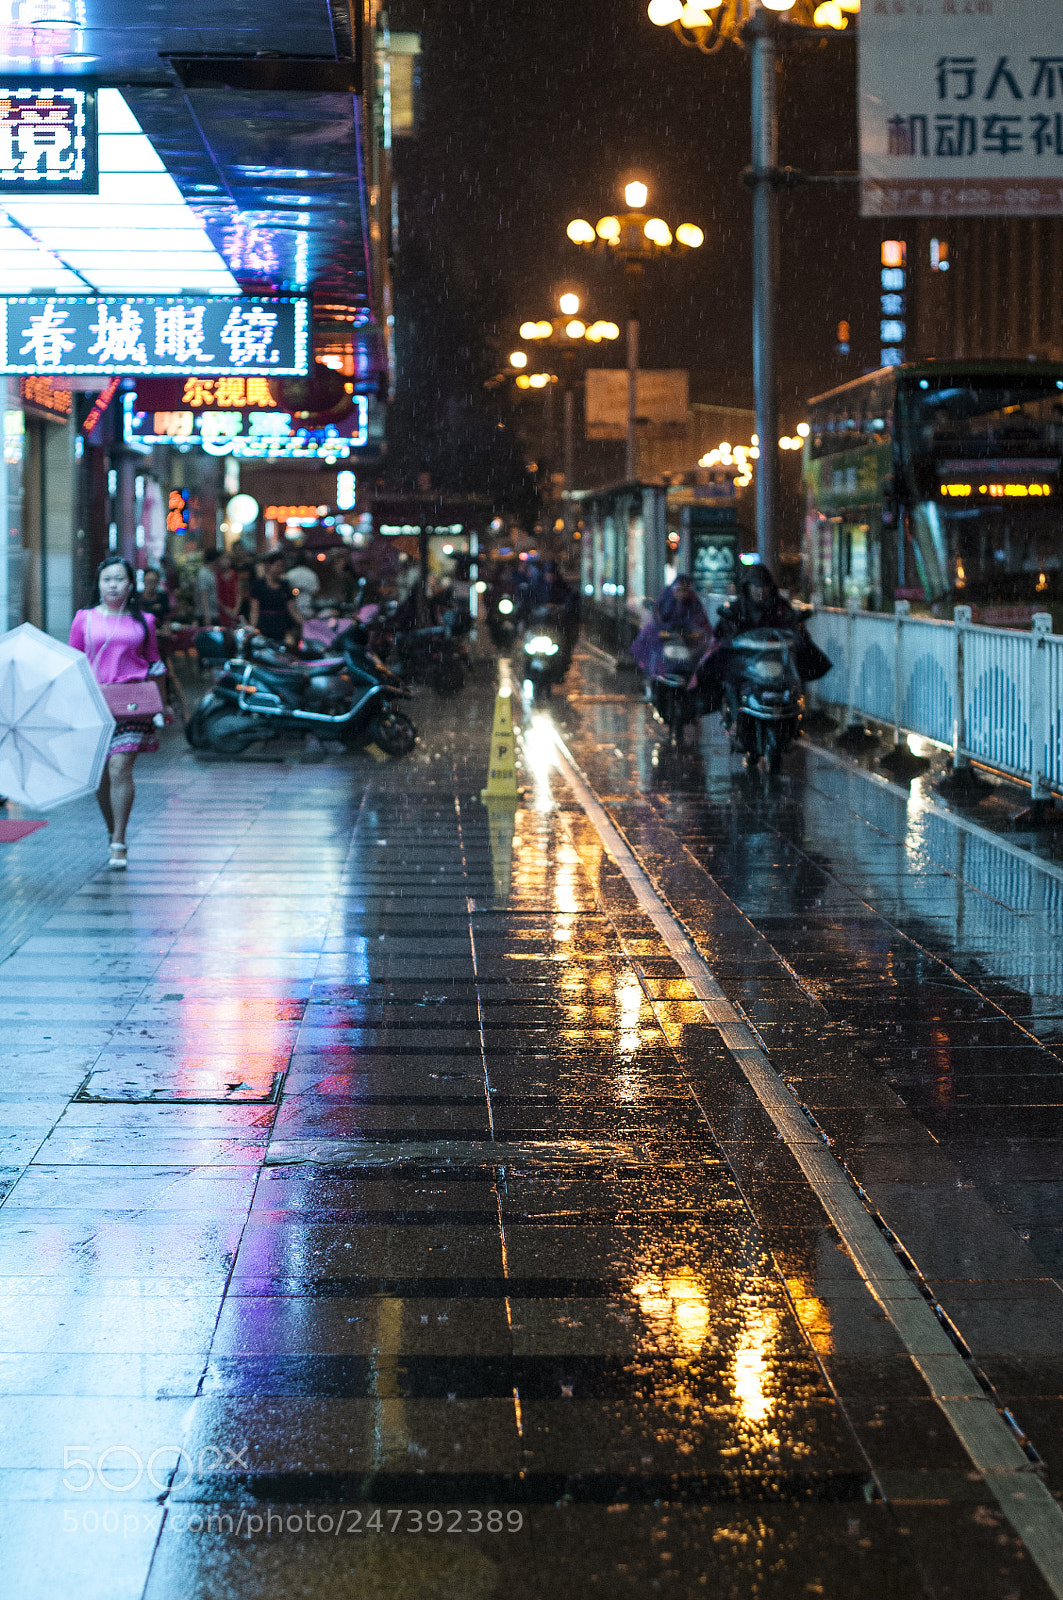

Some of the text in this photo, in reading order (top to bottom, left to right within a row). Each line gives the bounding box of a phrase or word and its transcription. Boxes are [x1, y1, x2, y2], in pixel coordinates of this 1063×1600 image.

[935, 56, 1063, 100] 行人不
[887, 113, 1063, 157] 机动车礼
[19, 304, 281, 366] 春城眼镜
